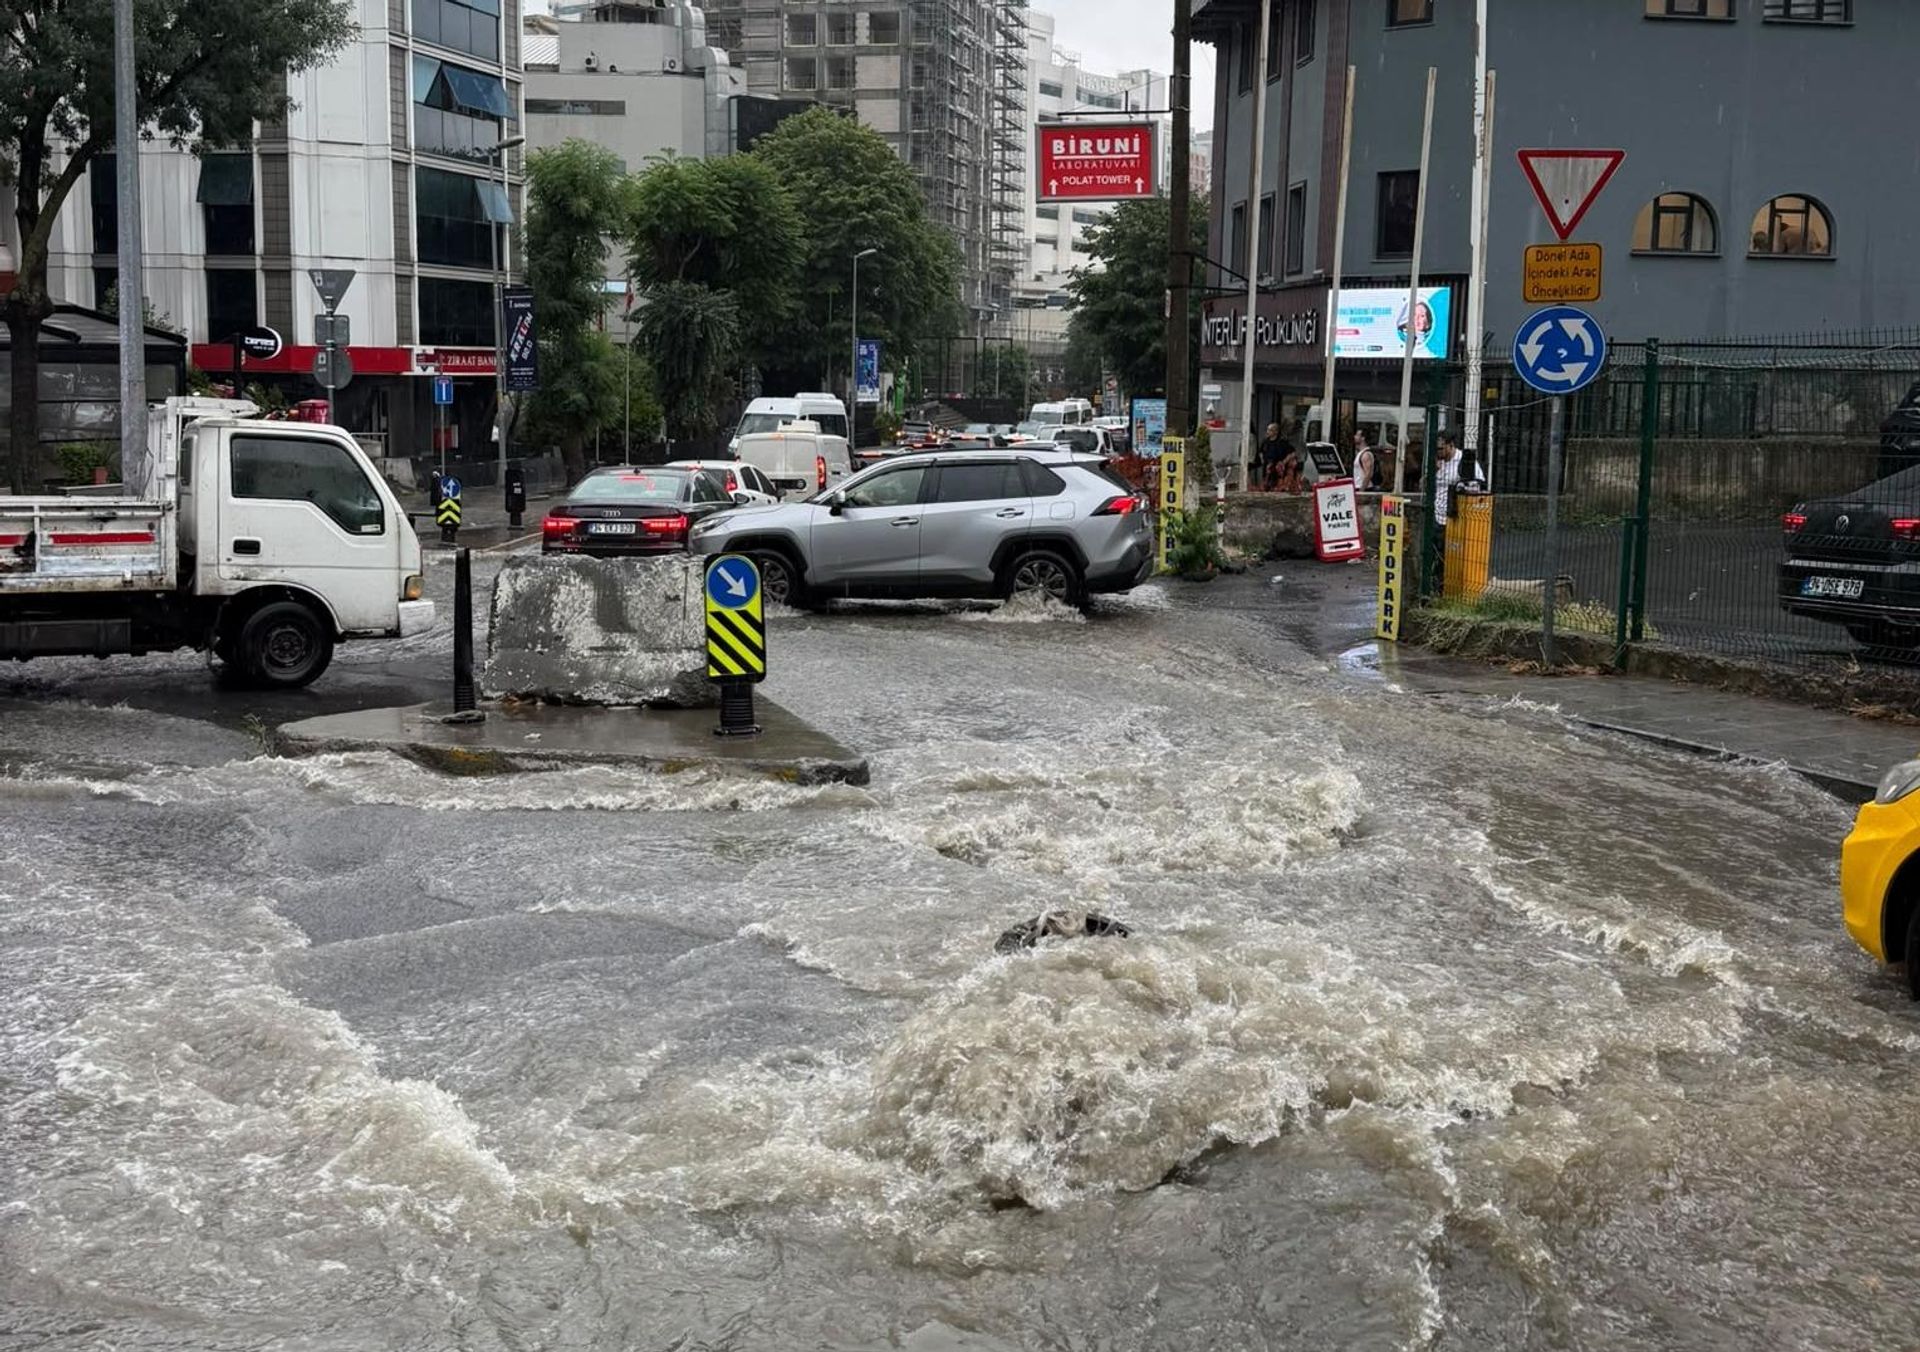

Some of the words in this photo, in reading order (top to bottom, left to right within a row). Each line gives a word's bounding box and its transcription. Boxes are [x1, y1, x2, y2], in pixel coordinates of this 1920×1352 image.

[1052, 133, 1140, 154] BİRUNİ
[1052, 159, 1140, 170] LABORATUVARI
[1062, 175, 1094, 185] POLAT
[1095, 174, 1131, 185] TOWER
[1570, 249, 1591, 261] Ada
[1163, 441, 1183, 454] VALE
[1383, 500, 1402, 517] VALE
[1322, 510, 1354, 523] VALE
[1382, 522, 1397, 634] OTOPARK
